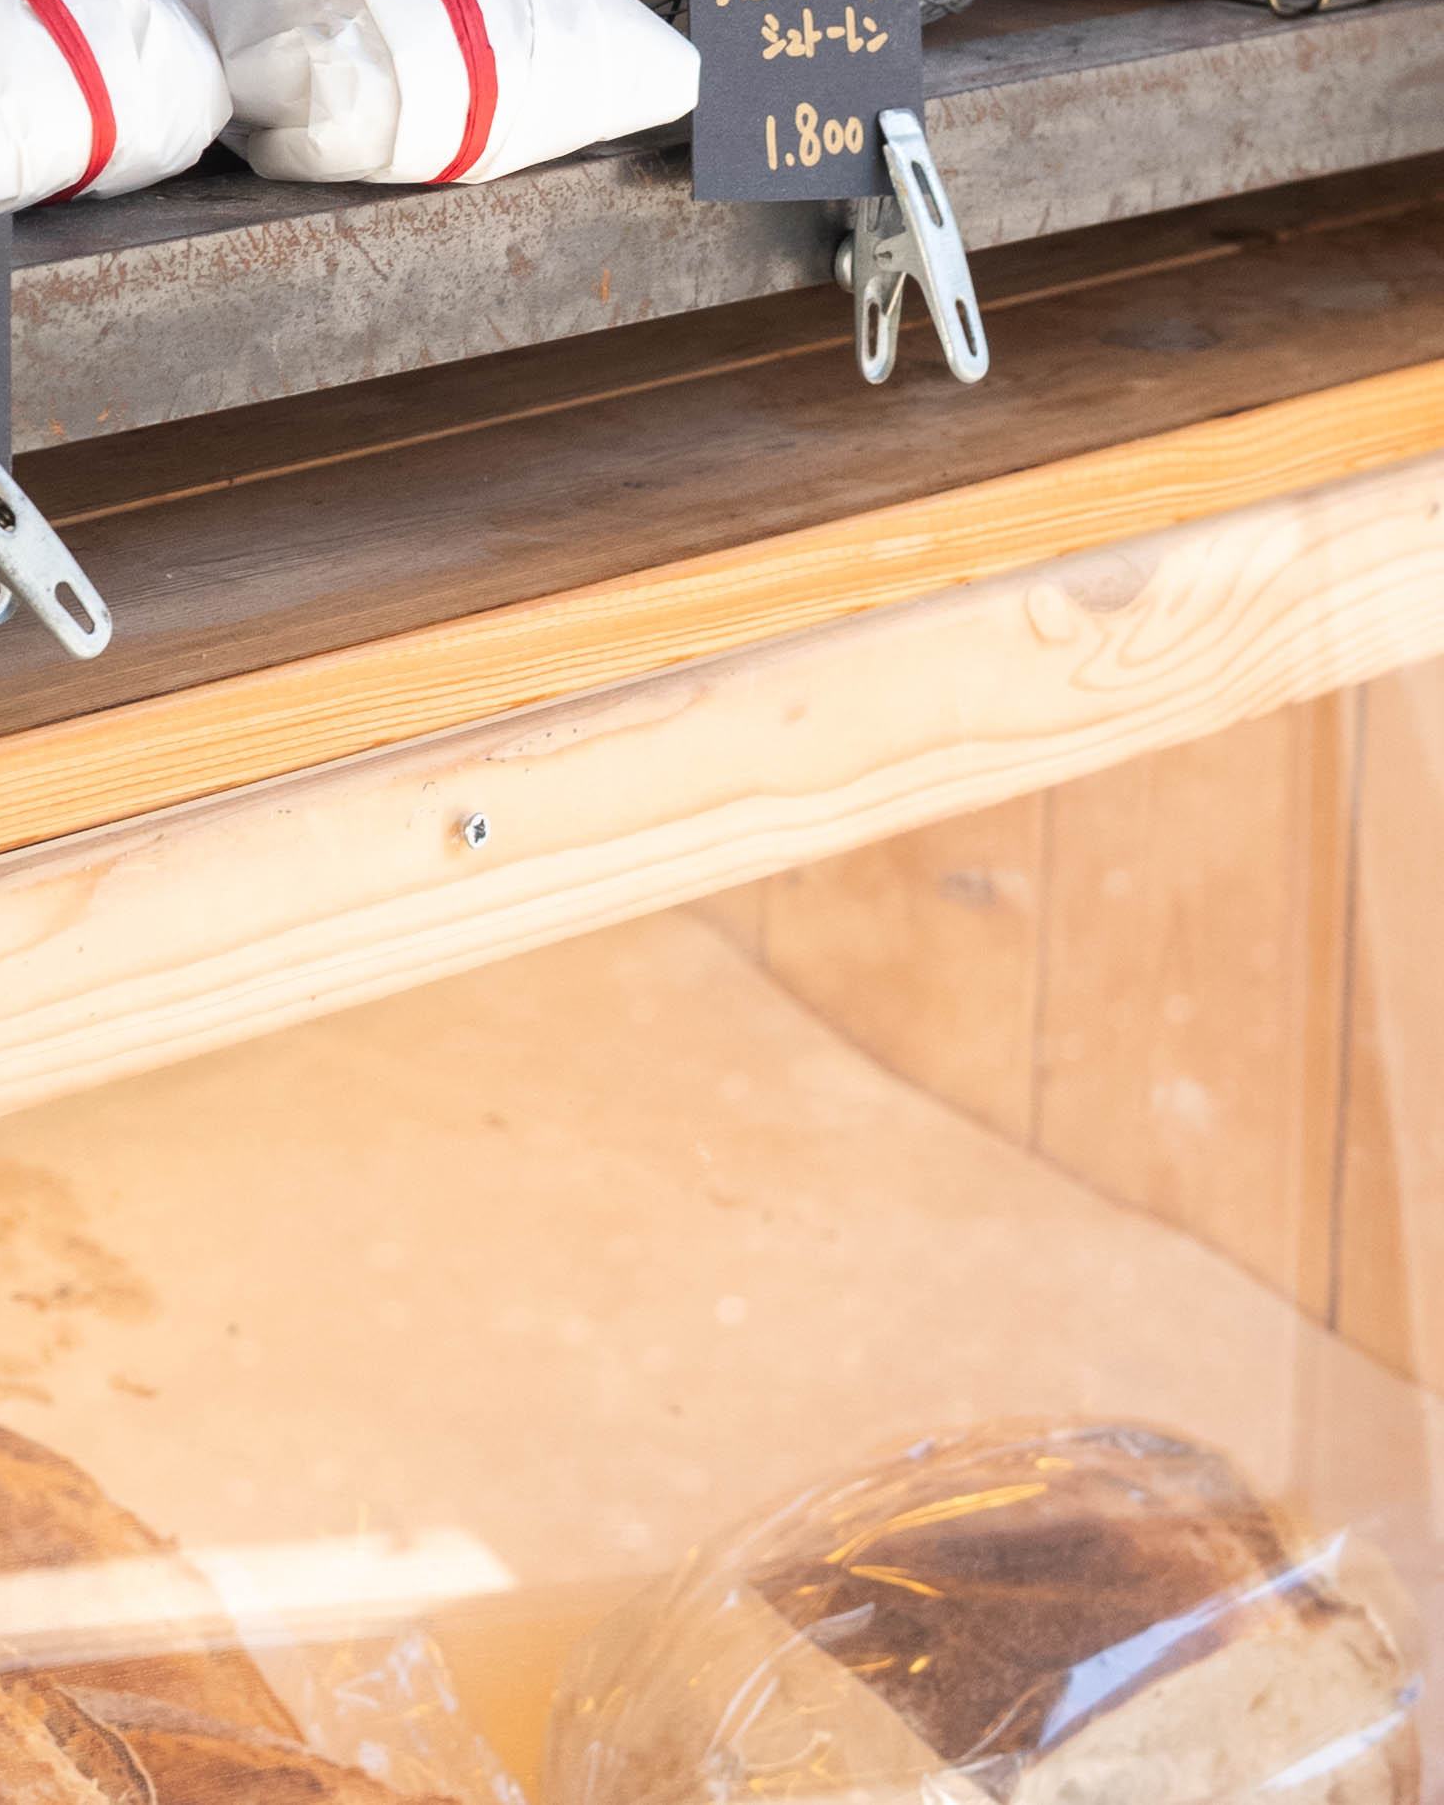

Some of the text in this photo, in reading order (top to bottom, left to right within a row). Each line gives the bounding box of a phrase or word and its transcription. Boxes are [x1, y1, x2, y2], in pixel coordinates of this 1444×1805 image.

[761, 6, 889, 59] シュトーレン
[766, 102, 864, 170] 1.800
